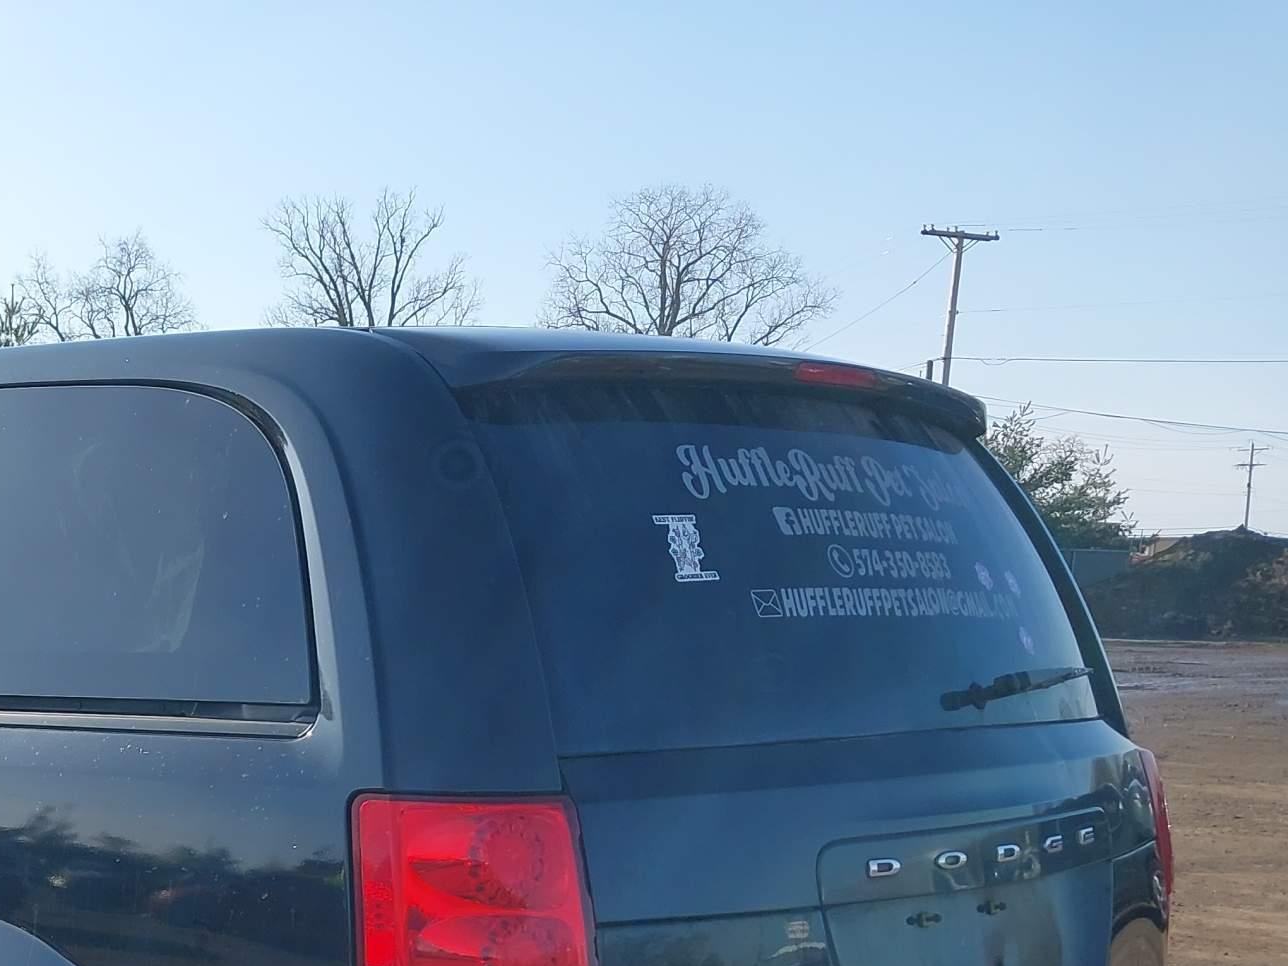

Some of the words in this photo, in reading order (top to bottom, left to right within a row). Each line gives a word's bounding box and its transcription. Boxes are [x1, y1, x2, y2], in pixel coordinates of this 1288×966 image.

[797, 508, 893, 538] HUFFLERUFF
[890, 513, 919, 540] PET
[918, 516, 959, 545] SALON
[852, 548, 952, 579] 574-350-8583
[867, 827, 1096, 878] DODGE
